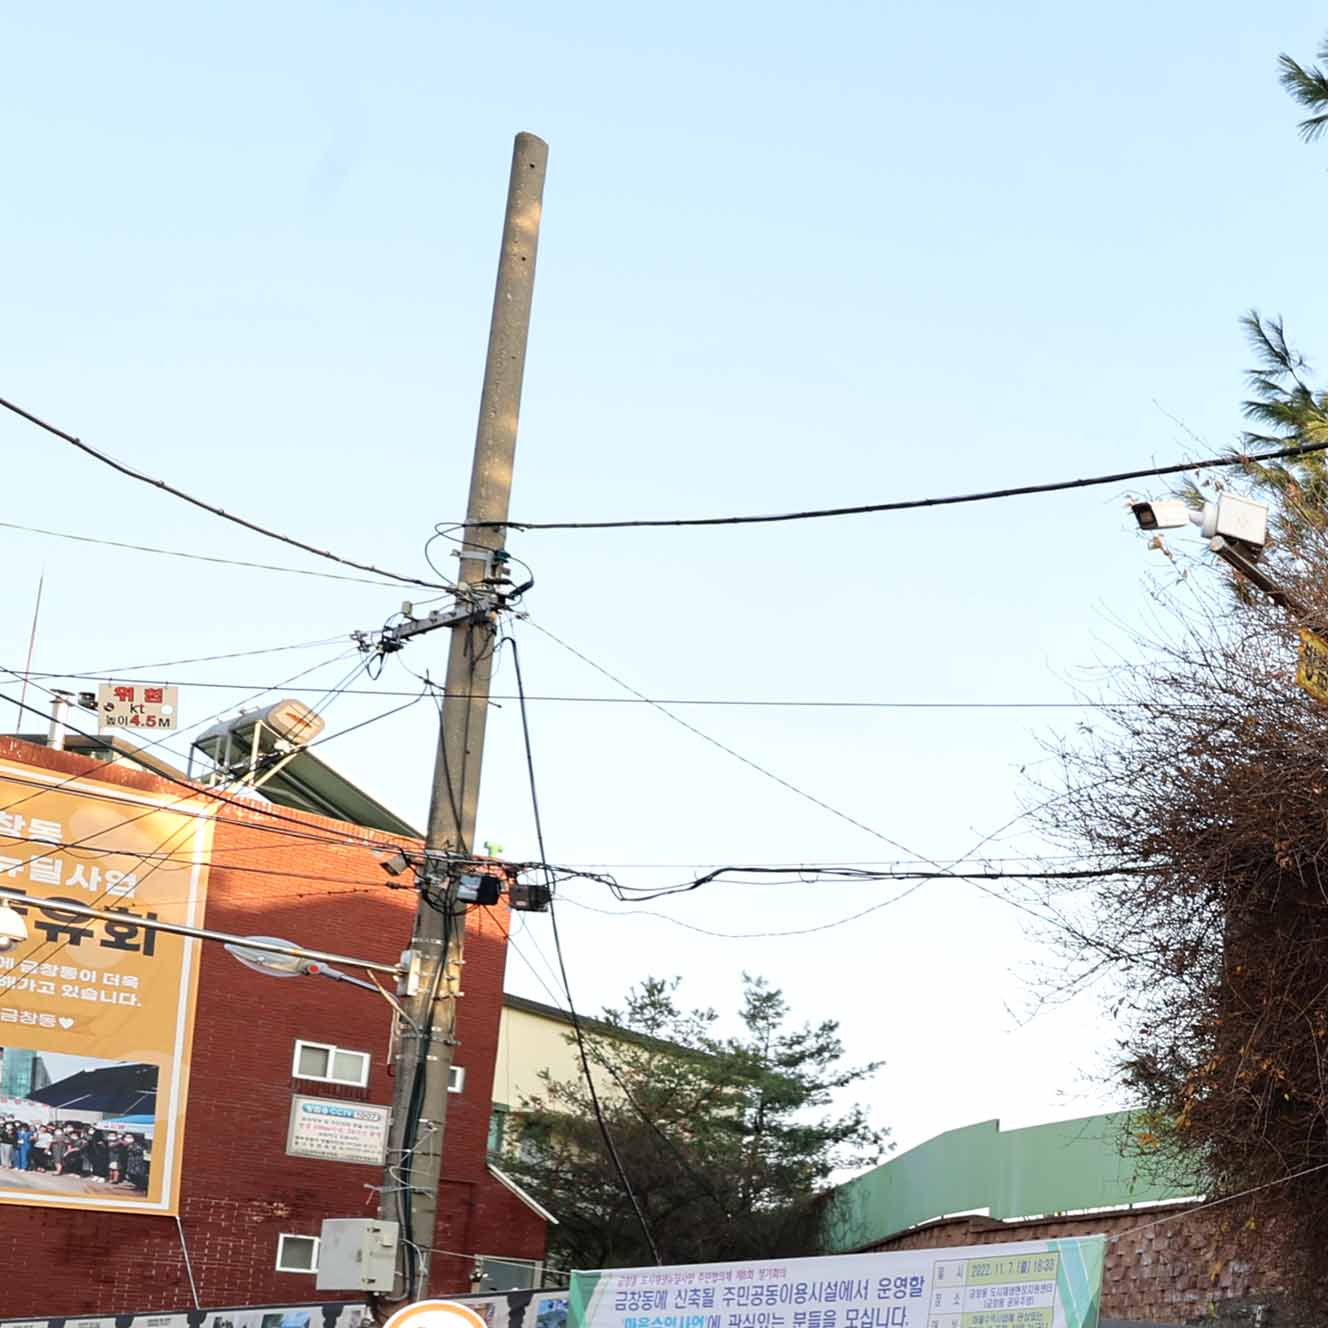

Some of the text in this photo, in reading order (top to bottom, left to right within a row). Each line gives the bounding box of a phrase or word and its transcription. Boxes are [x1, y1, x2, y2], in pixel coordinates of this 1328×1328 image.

[615, 1275, 924, 1311] 금창동에 신축될 주민공동이용시설에서 운영할
